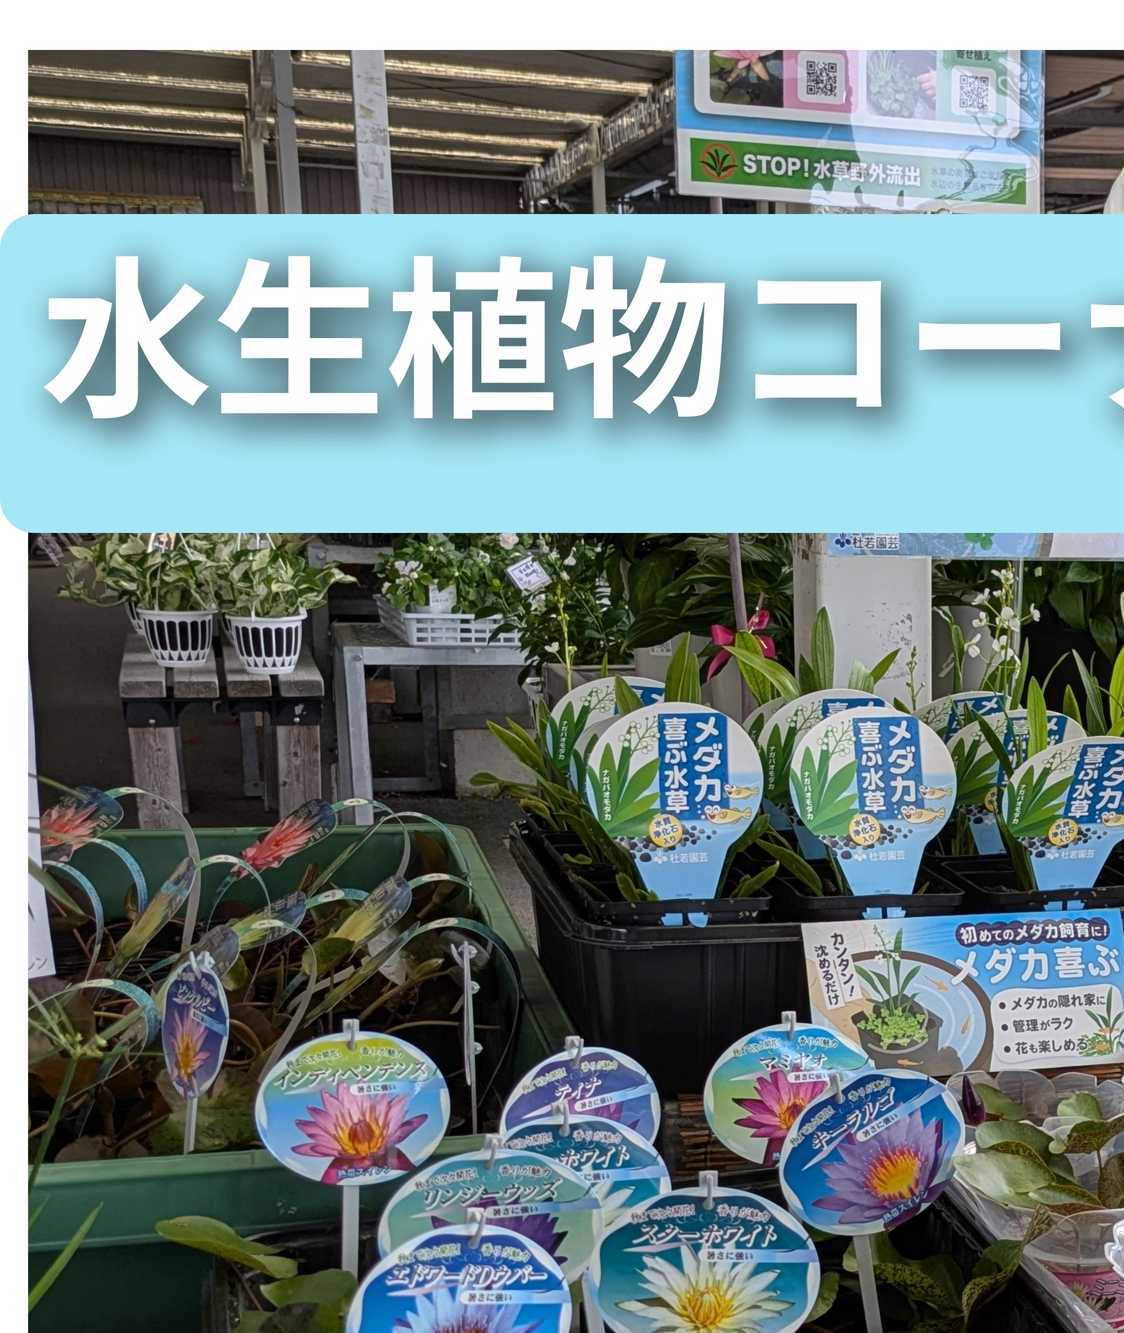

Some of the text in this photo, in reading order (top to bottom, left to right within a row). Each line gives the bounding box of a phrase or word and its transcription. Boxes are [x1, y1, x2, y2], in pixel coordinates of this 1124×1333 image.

[663, 717, 690, 814] 喜ぶ水草
[694, 718, 722, 802] メダカ
[858, 720, 888, 814] 喜ぶ水草
[889, 719, 917, 804] メダカ
[1070, 744, 1108, 817] 喜ぶ水草
[830, 931, 855, 998] カンタン!
[959, 924, 1108, 944] 初めてのメダカ飼育に!
[815, 945, 839, 1006] 沈めるだけ
[951, 946, 1120, 985] メダカ喜ぶ
[1012, 994, 1105, 1011] メダカの隠れ家に
[1012, 1017, 1073, 1033] 管理がラク
[1015, 1038, 1087, 1055] 花も楽しめる
[811, 1087, 896, 1150] キーラルゴ
[424, 1178, 562, 1211] リンジーウッズ
[631, 1225, 778, 1249] スターホワイト
